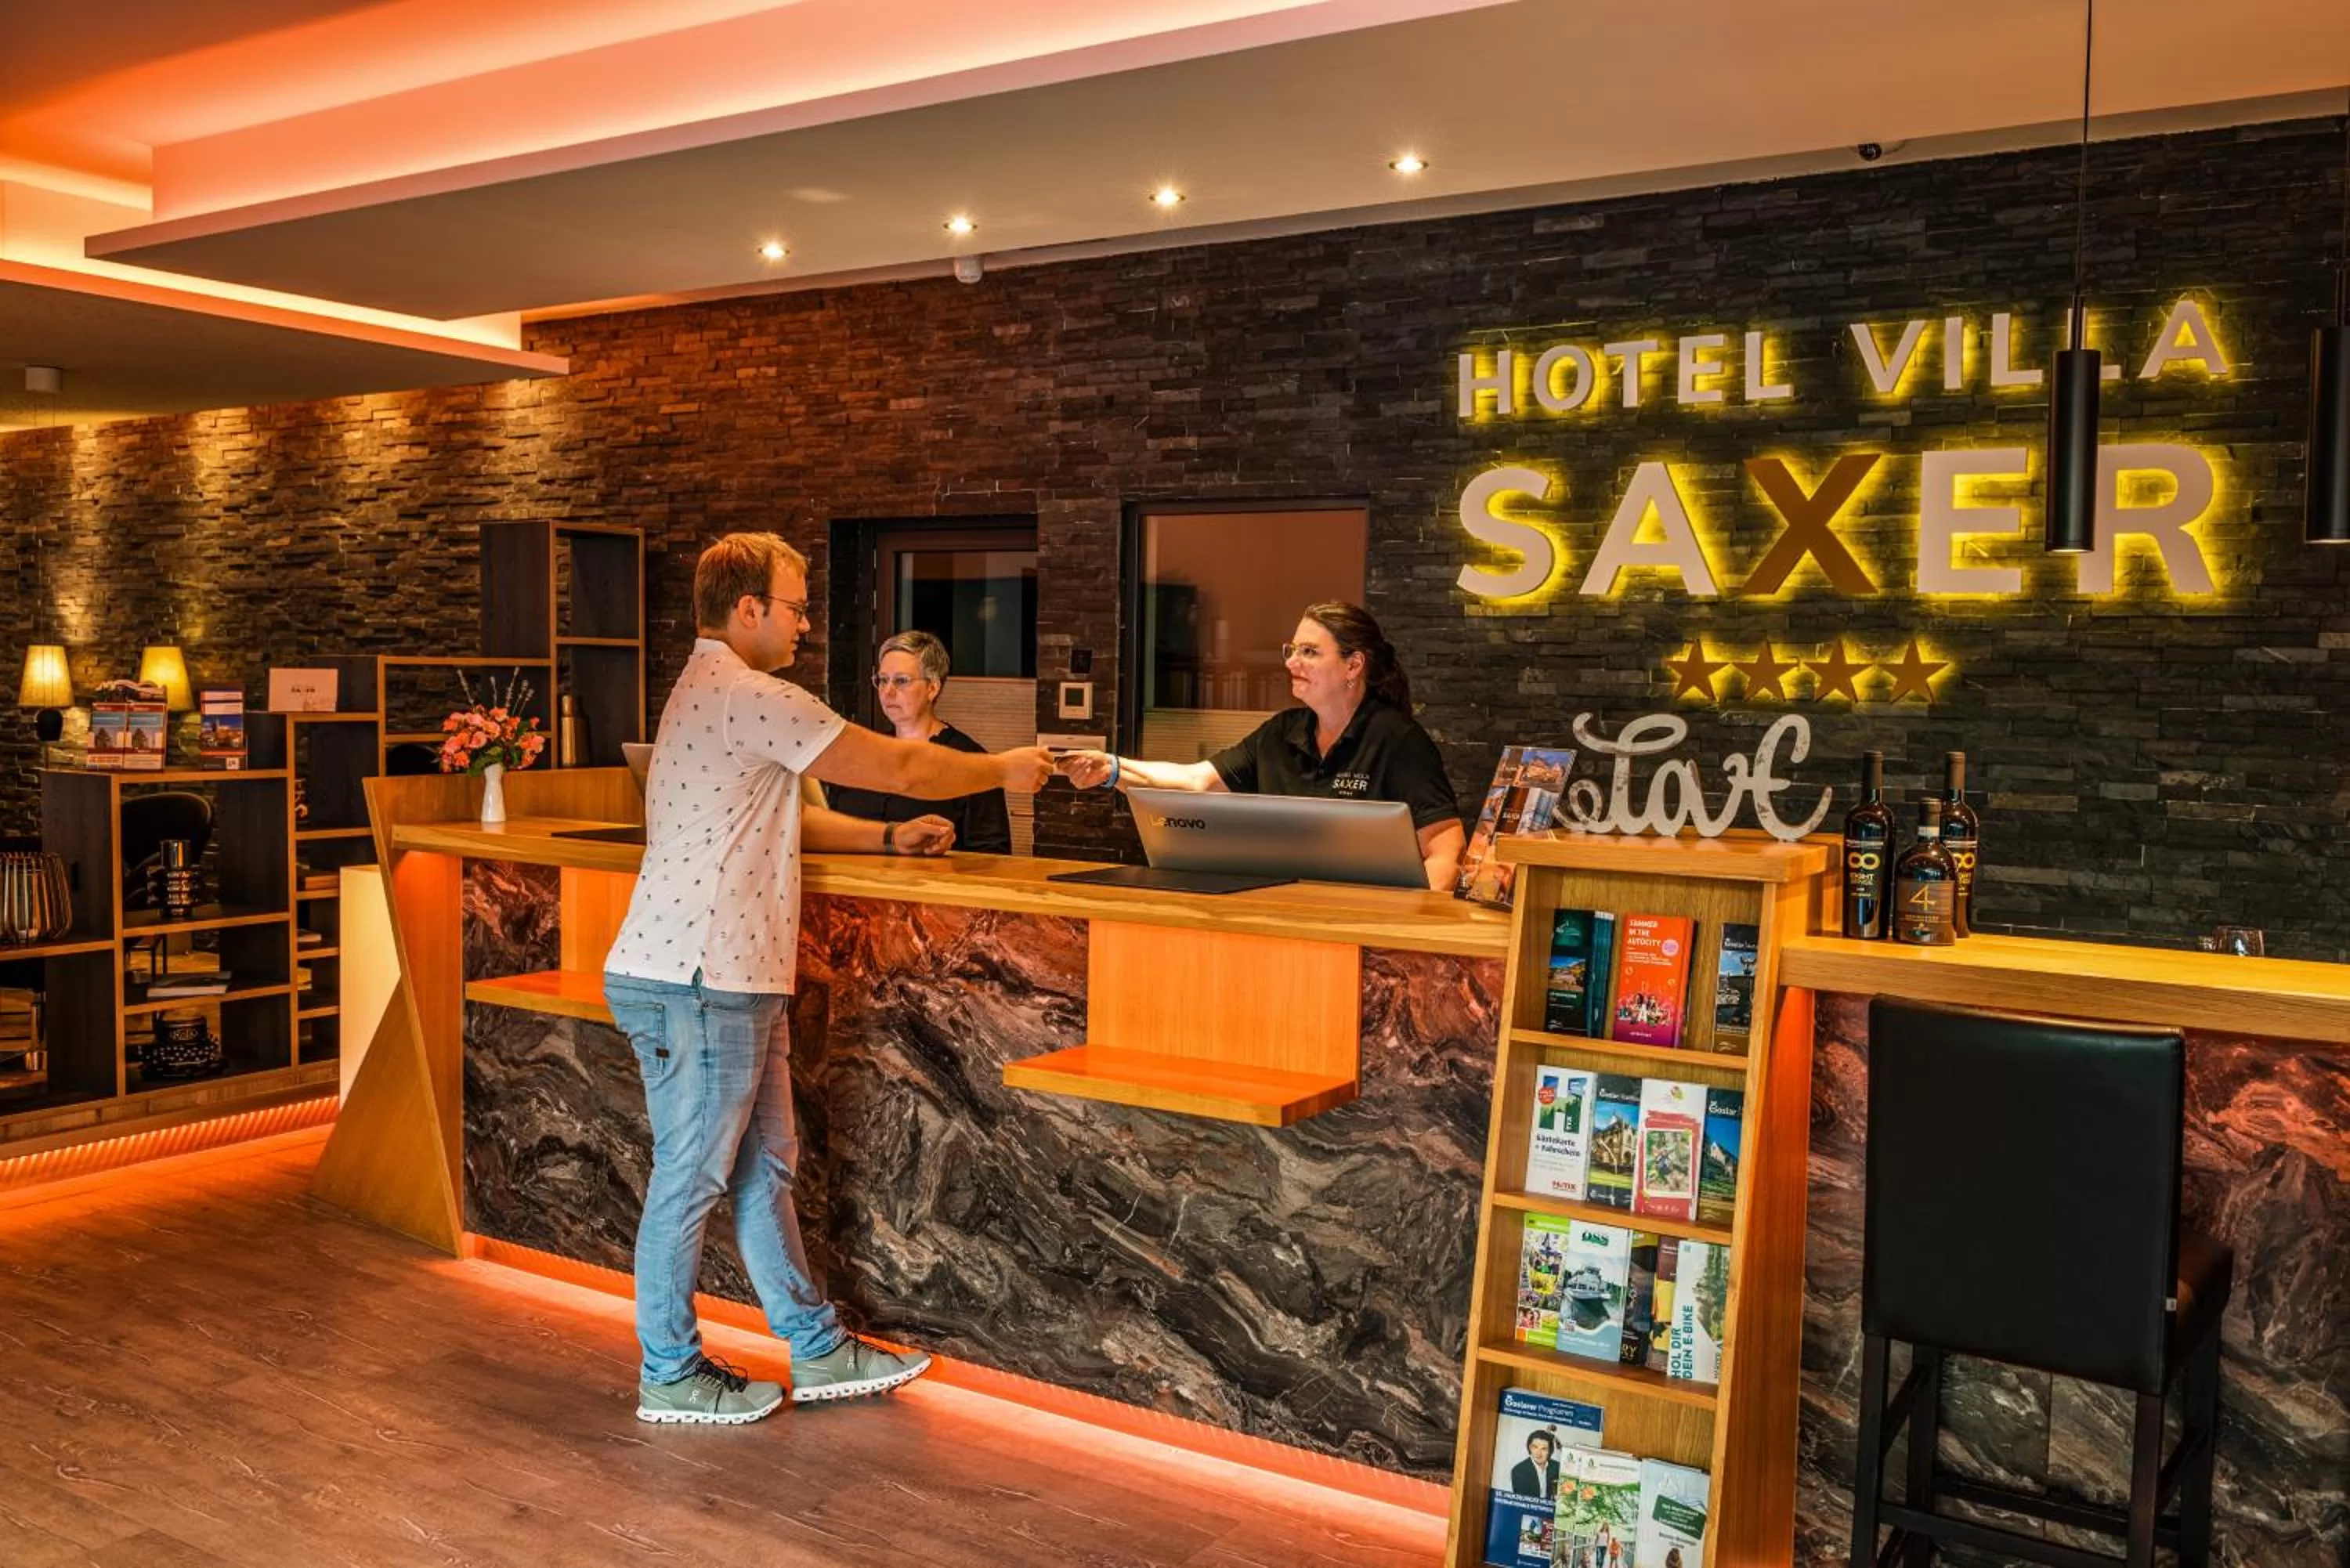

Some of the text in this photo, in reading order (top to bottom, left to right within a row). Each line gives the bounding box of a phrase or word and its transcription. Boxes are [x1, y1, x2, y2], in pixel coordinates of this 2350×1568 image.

[1458, 331, 1794, 417] HOTEL
[1457, 443, 2217, 598] SAXER
[1332, 779, 1368, 792] SAXER
[1148, 815, 1206, 830] Lenovo
[1909, 884, 1936, 910] 4
[1708, 1101, 1737, 1115] Goslar
[1671, 1328, 1681, 1378] HOL DIR
[1683, 1306, 1693, 1378] DEIN E-BIKE
